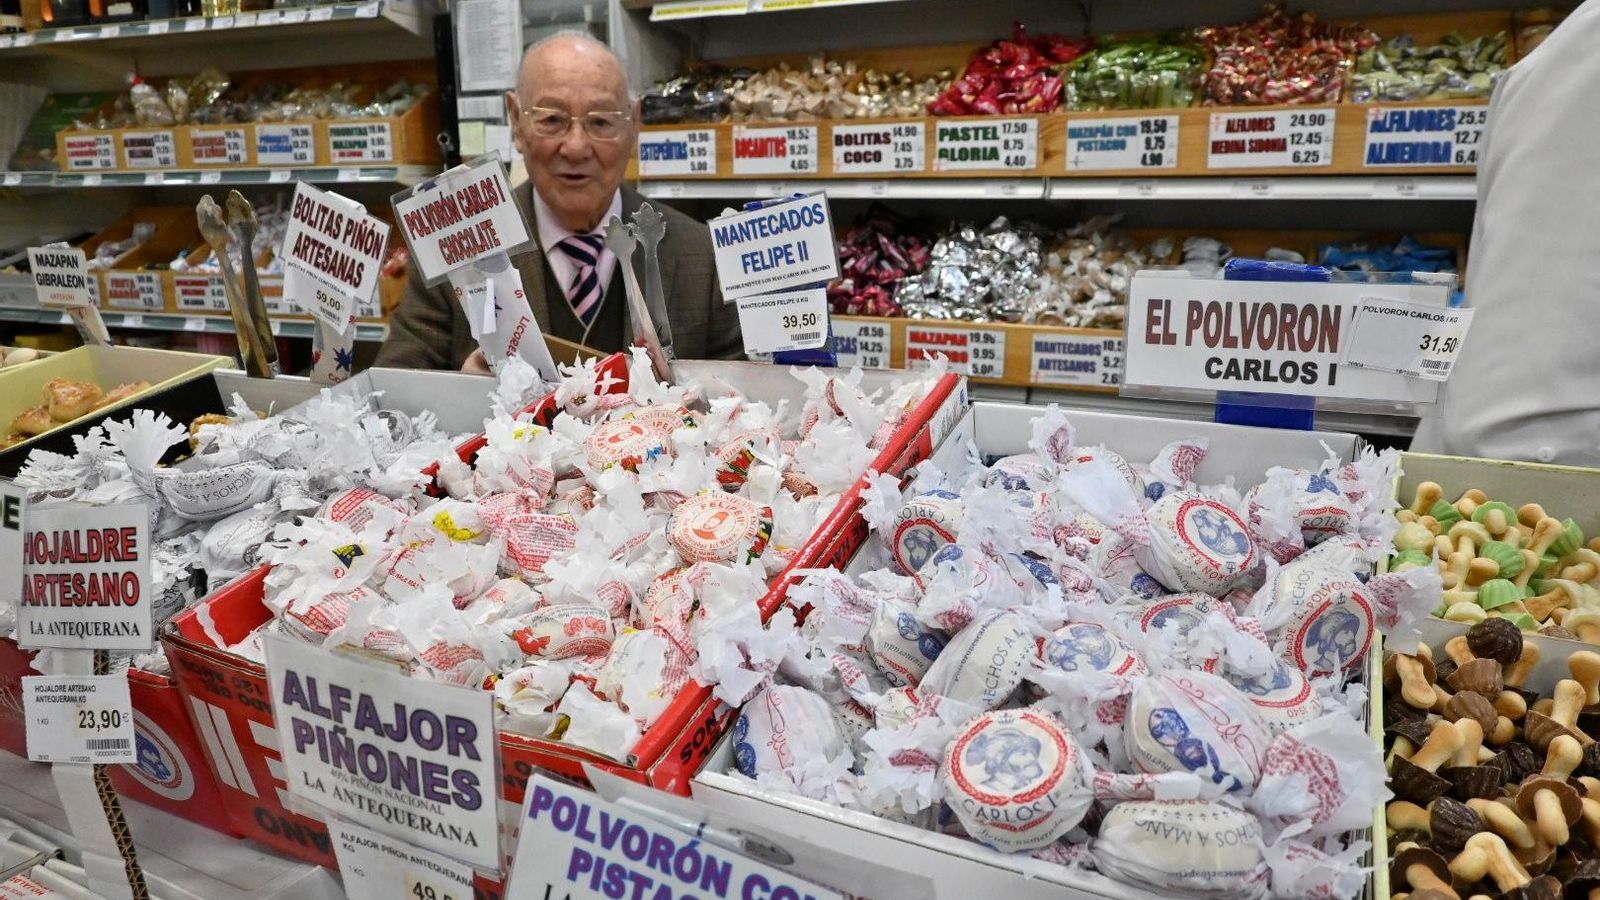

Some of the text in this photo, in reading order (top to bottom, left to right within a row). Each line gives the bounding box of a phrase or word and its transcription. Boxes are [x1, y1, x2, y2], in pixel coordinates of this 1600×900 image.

[1226, 117, 1275, 133] ALFAJORES
[1290, 113, 1326, 127] 24.90
[1370, 108, 1456, 133] ALFAJORES
[1457, 110, 1486, 125] 25.5
[938, 126, 999, 142] PASTEL
[1002, 122, 1027, 134] 17.50
[1140, 119, 1167, 133] 19.50
[835, 132, 891, 147] BOLITAS
[1290, 132, 1322, 146] 12.45
[1455, 131, 1482, 144] 12.7
[844, 150, 881, 164] COCO
[938, 146, 999, 162] GLORIA
[1292, 151, 1319, 163] 6.25
[1366, 141, 1451, 164] ALMENDRA
[1455, 150, 1478, 164] 6.4
[404, 191, 463, 241] POLVORÓN
[456, 176, 500, 219] CARLOS
[293, 192, 384, 261] BOLITAS PIÑÓN
[714, 203, 825, 248] MANTECADOS
[438, 218, 501, 266] CHOCOLATE
[36, 254, 79, 269] MAZAPAN
[292, 231, 365, 288] ARTESANAS
[741, 240, 809, 274] FELIPE II
[36, 273, 85, 289] GIBRALEON
[740, 300, 776, 309] MANTECADOS
[777, 298, 795, 306] FELIPE
[1362, 305, 1409, 317] POLVORON
[1410, 311, 1445, 322] CARLOS
[1144, 298, 1342, 354] EL POLVORON
[909, 330, 968, 346] MAZAPAN
[860, 341, 883, 353] 14.25
[1034, 340, 1102, 357] MANTECADOS
[1038, 358, 1097, 373] ARTESANOS
[1103, 356, 1120, 368] 5.2
[1101, 372, 1119, 384] 2.6
[1204, 356, 1338, 387] CARLOS I
[2, 494, 21, 531] E
[23, 526, 138, 565] HOJALDRE
[21, 571, 140, 607] ARTESANO
[30, 620, 141, 640] LA ANTEQUERANA
[35, 684, 97, 693] HOJALDRE ARTESANO
[35, 695, 87, 703] ANTEQUERANA KG
[282, 669, 482, 762] ALFAJOR
[291, 717, 483, 812] PIÑONES
[302, 770, 479, 848] LA ANTEQUERANA
[384, 788, 446, 816] NACIONAL
[962, 798, 1043, 823] CARLOS
[528, 785, 733, 898] POLVORÓN
[340, 832, 379, 850] ALFAJOR
[410, 855, 474, 888] ANTEQUERANA
